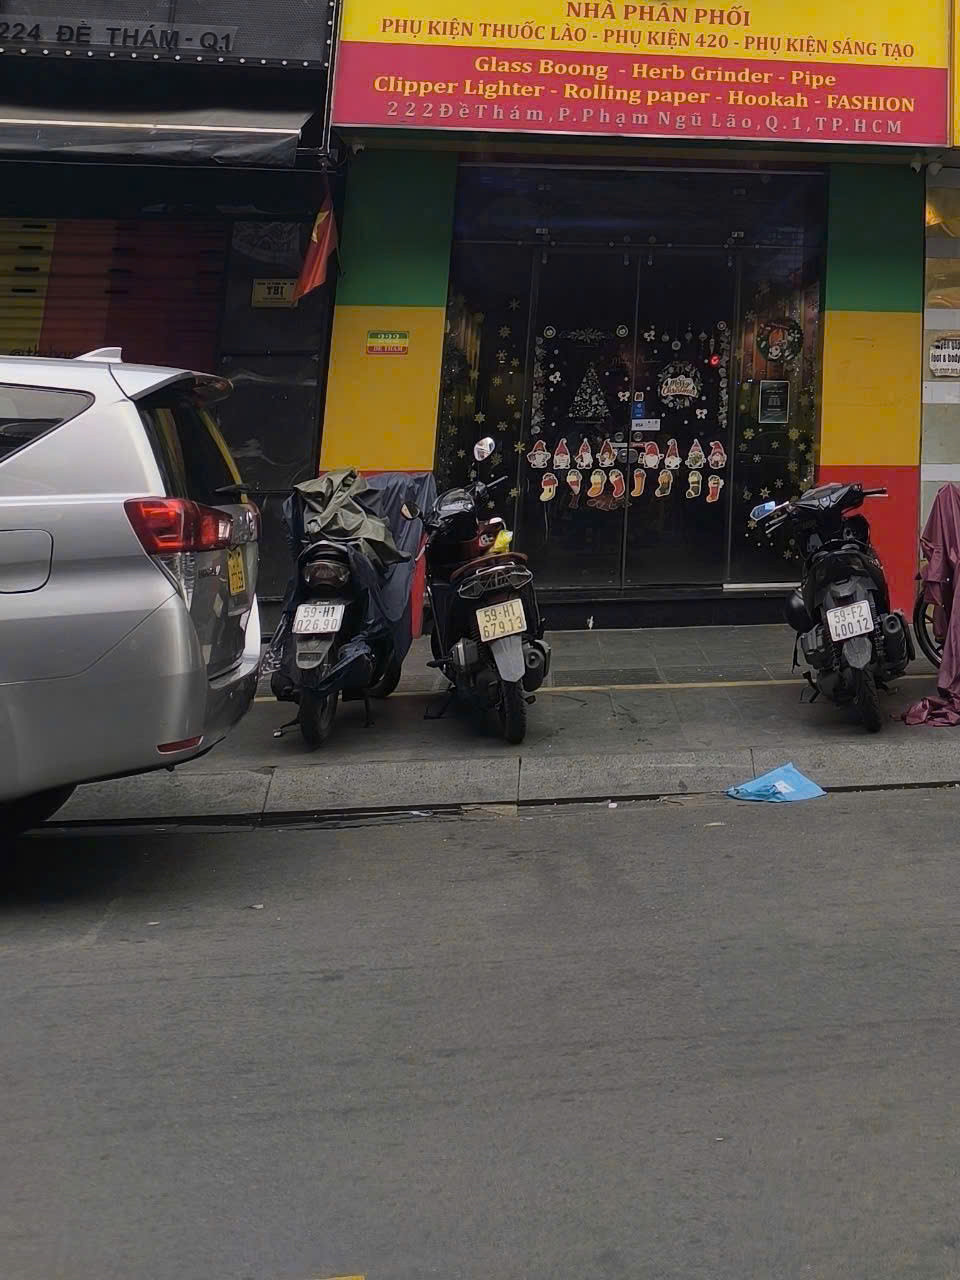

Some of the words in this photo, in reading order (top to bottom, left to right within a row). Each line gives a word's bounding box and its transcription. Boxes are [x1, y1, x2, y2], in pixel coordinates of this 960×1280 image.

[623, 1, 688, 24] PHÂN
[694, 4, 751, 27] PHỐI
[0, 23, 41, 41] 224
[106, 23, 179, 49] THÁM
[200, 31, 232, 52] Q.1
[381, 18, 423, 39] PHỤ
[427, 17, 474, 41] KIỆN
[479, 20, 546, 41] THUỐC
[551, 22, 587, 42] LÀO
[603, 27, 642, 48] PHỤ
[647, 28, 691, 50] KIỆN
[695, 33, 730, 49] 420
[744, 35, 782, 55] PHỤ
[786, 34, 828, 57] KIỆN
[832, 36, 877, 57] SÁNG
[881, 42, 915, 62] TẠO
[474, 56, 533, 74] Glass
[538, 59, 609, 80] Boong
[632, 63, 686, 81] Herb
[691, 65, 774, 85] Grinder
[790, 70, 838, 90] Pipe
[373, 75, 459, 98] Clipper
[463, 78, 546, 100] Lighter
[563, 82, 642, 106] Rolling
[646, 89, 711, 108] paper
[728, 89, 809, 108] Hookah
[826, 94, 916, 113] FASHION
[303, 606, 336, 618] 59-H1
[483, 603, 516, 623] 59-H1
[833, 605, 864, 624] 59-F2
[296, 619, 338, 632] 026.90
[483, 616, 523, 638] 679.13
[834, 617, 870, 638] 400.12
